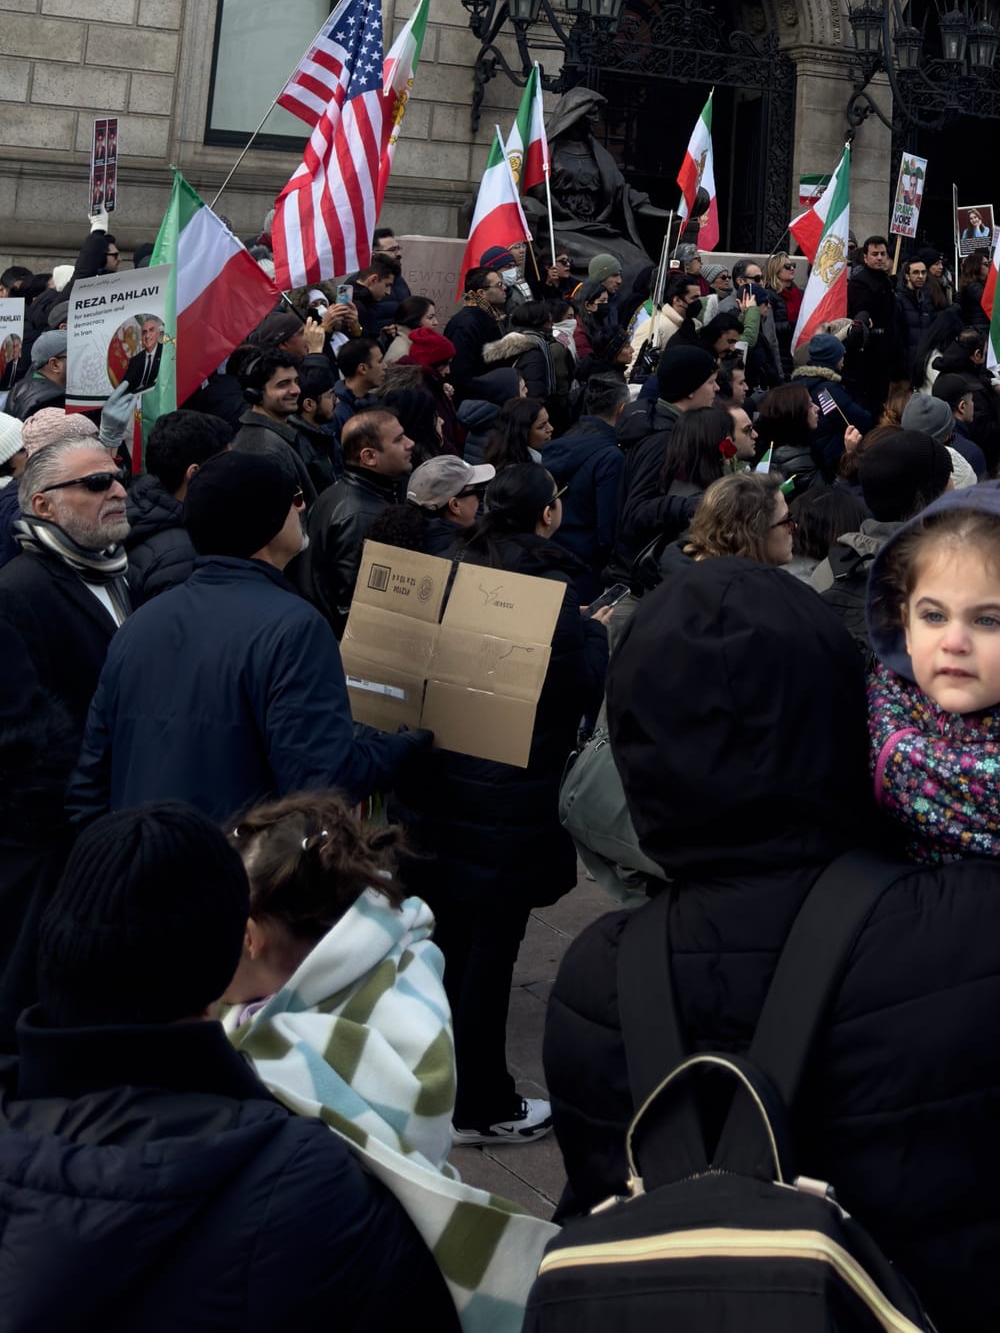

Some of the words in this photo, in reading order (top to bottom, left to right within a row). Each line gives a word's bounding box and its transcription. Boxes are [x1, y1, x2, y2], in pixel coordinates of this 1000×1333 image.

[408, 270, 457, 284] EWTO
[75, 296, 107, 311] REZA
[110, 286, 160, 304] PAHLAVI
